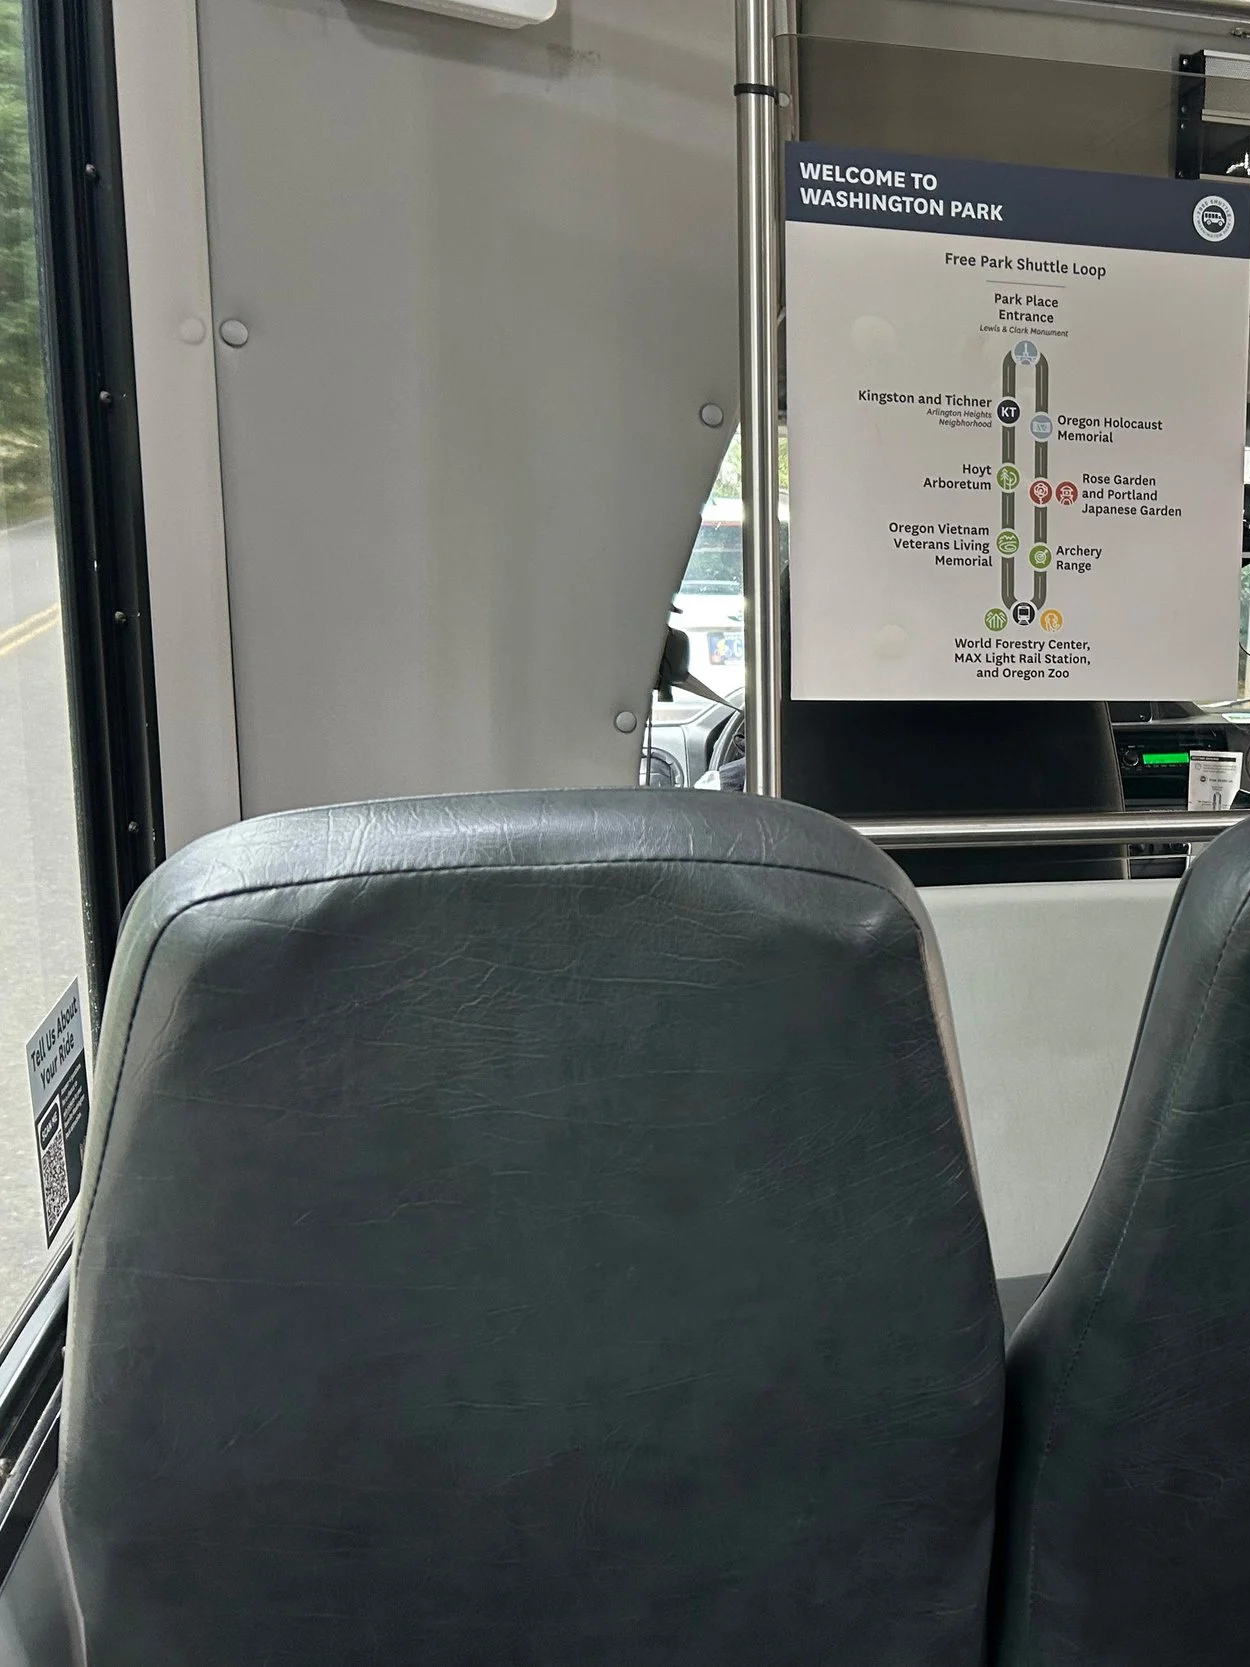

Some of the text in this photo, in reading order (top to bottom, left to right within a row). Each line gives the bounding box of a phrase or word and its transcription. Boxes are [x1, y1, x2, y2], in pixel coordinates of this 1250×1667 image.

[800, 162, 937, 190] WELCOME TO
[800, 188, 1002, 221] WASHINGTON PARK
[946, 253, 1106, 280] Free Park Shuttle Loop
[995, 294, 1058, 307] Park Place
[999, 310, 1053, 323] Entrance
[1030, 328, 1068, 337] Monument
[859, 390, 992, 407] Kingston and Tichner
[927, 409, 991, 419] Arlington Heights
[1001, 406, 1017, 419] KT
[1058, 415, 1162, 430] Oregon Holocaust
[1058, 431, 1113, 443] Memorial
[963, 464, 991, 477] Hoyt
[924, 477, 991, 490] Arboretum
[1083, 474, 1155, 486] Rose Garden
[1082, 488, 1157, 500] and Portland
[1082, 504, 1181, 516] Japanese Garden
[889, 523, 989, 536] Oregon Vietnam
[894, 539, 989, 554] Veterans Living
[1056, 545, 1102, 559] Archery
[936, 556, 992, 566] Memorial
[1057, 561, 1091, 573] Range
[955, 638, 1090, 652] World Forestry Center,
[955, 653, 1090, 666] MAX Light Rail Station,
[977, 667, 1069, 680] and Oregon Zoo
[31, 996, 77, 1072] Tell Us About
[41, 1056, 57, 1090] Your
[59, 1032, 74, 1065] Ride
